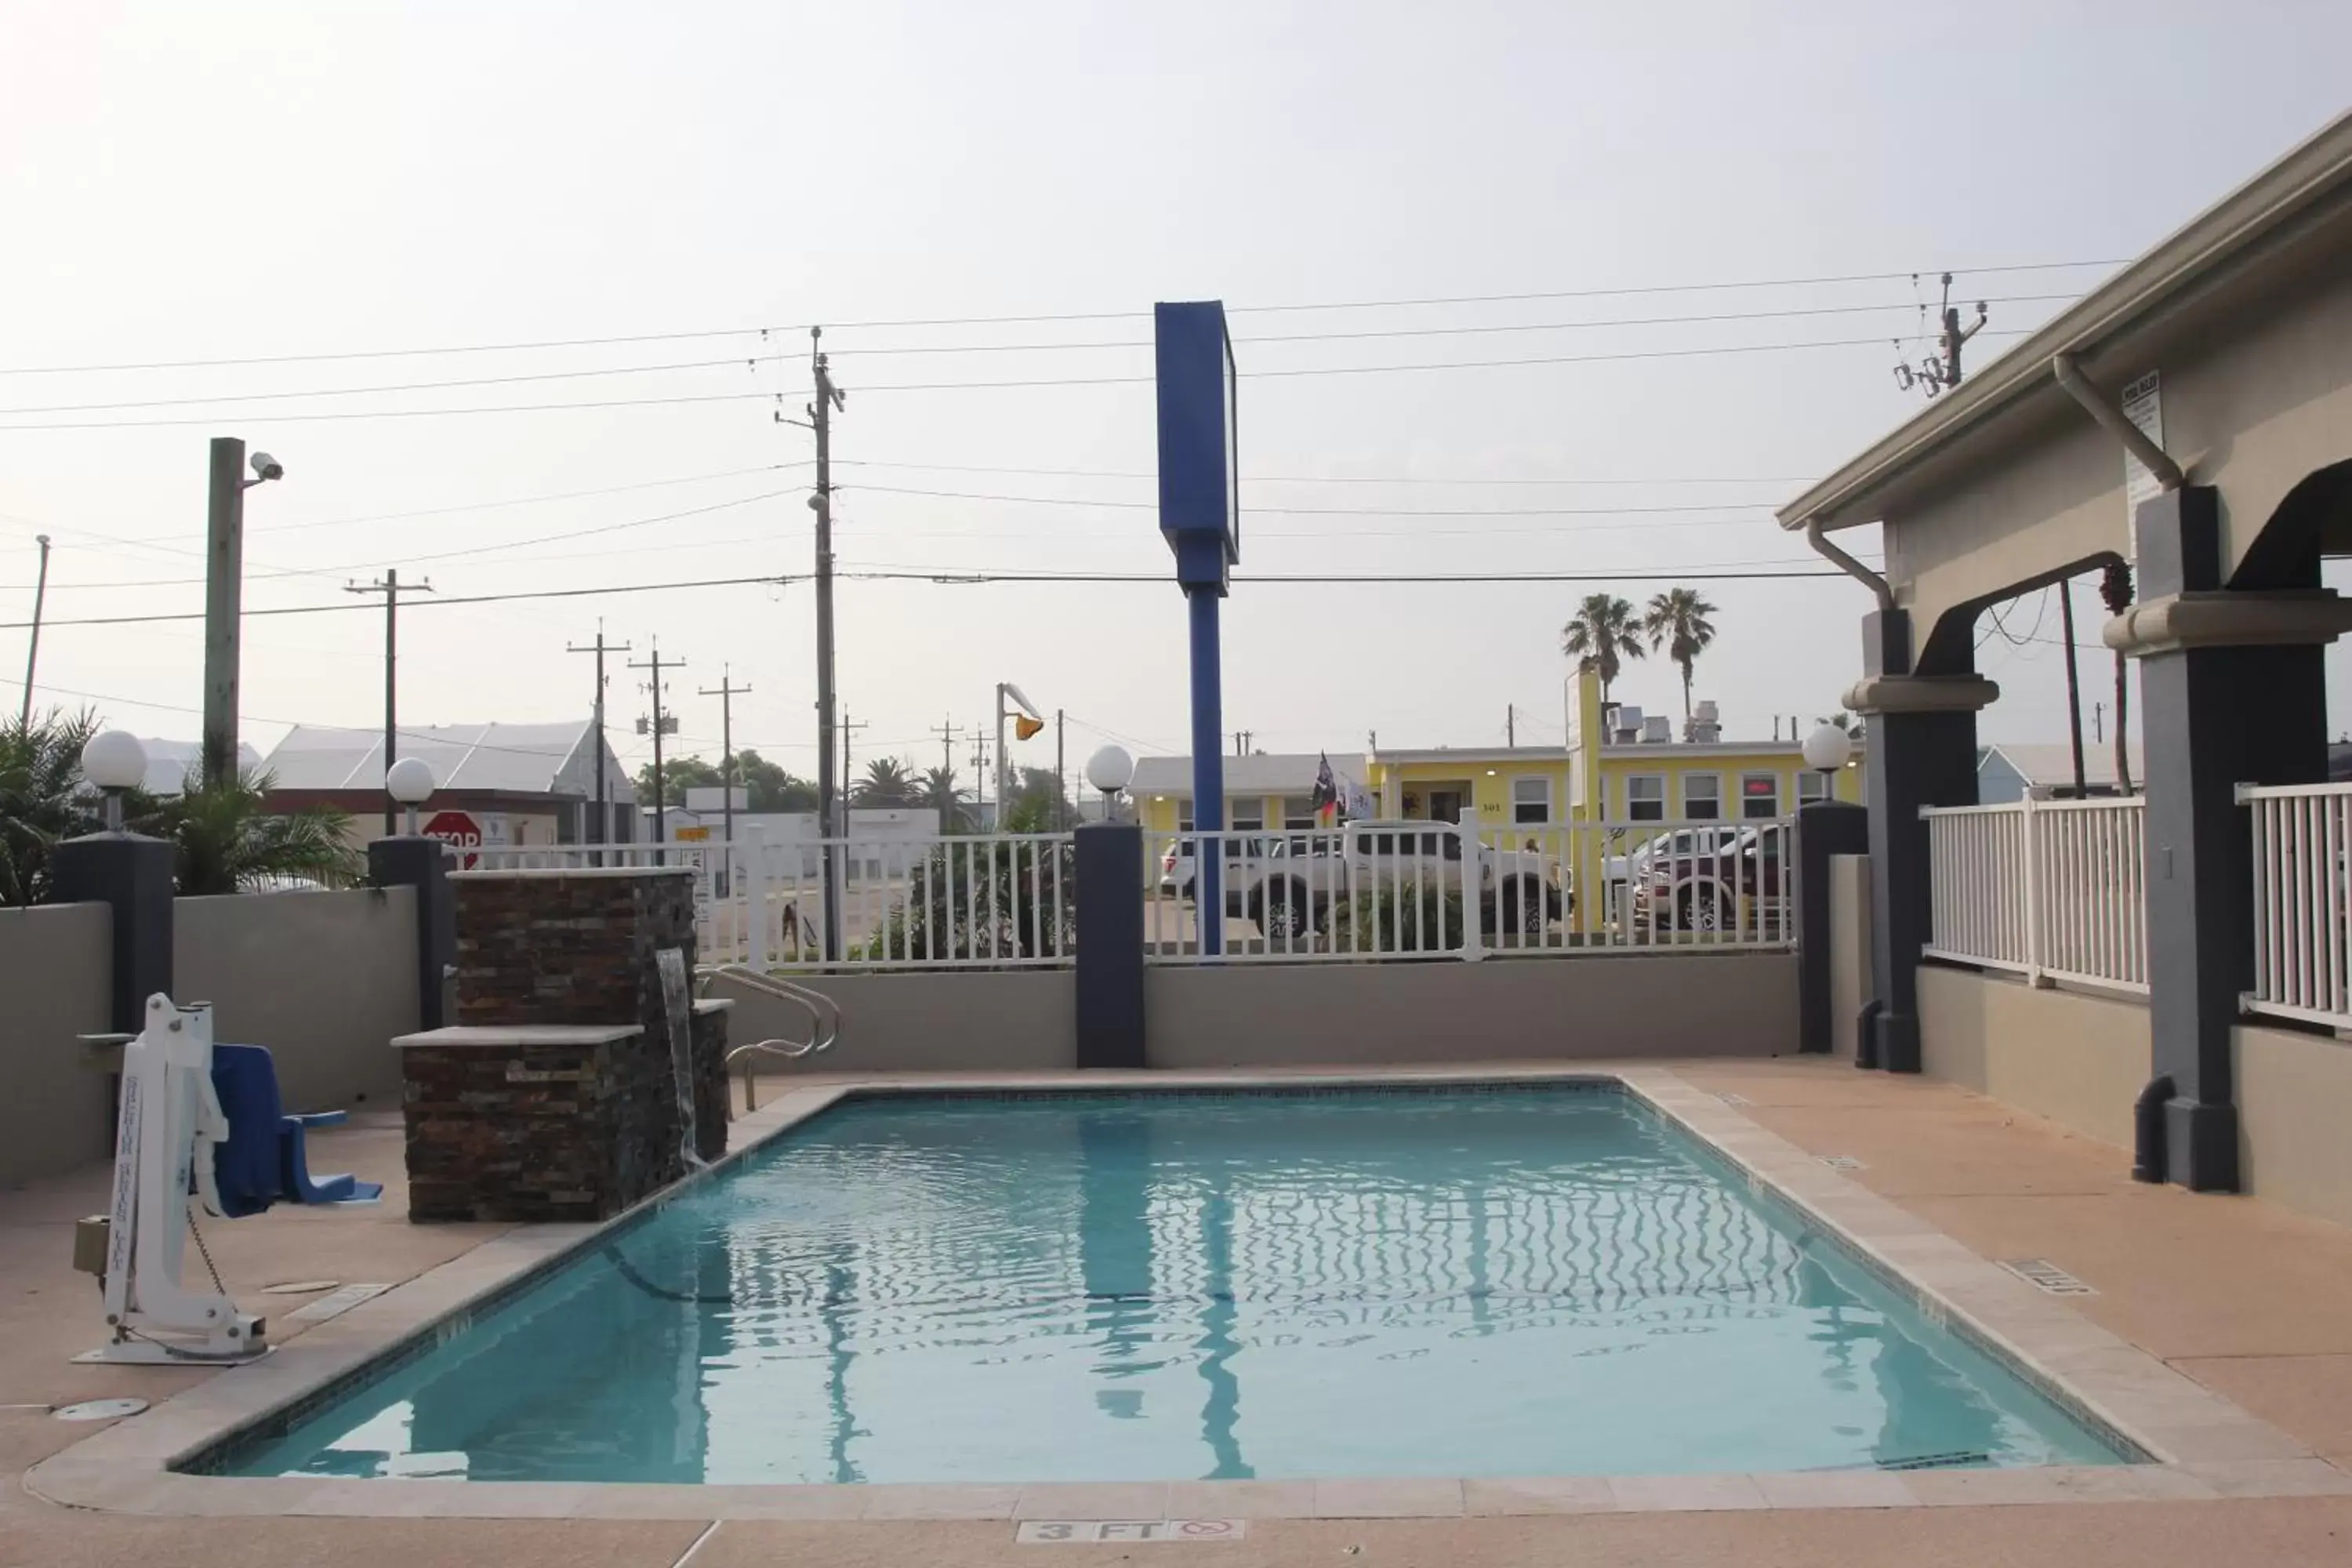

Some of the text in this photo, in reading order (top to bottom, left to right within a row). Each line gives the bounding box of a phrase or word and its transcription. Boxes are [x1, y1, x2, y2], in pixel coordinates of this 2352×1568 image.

[426, 831, 477, 848] OP
[1037, 1523, 1163, 1540] 3 FT
